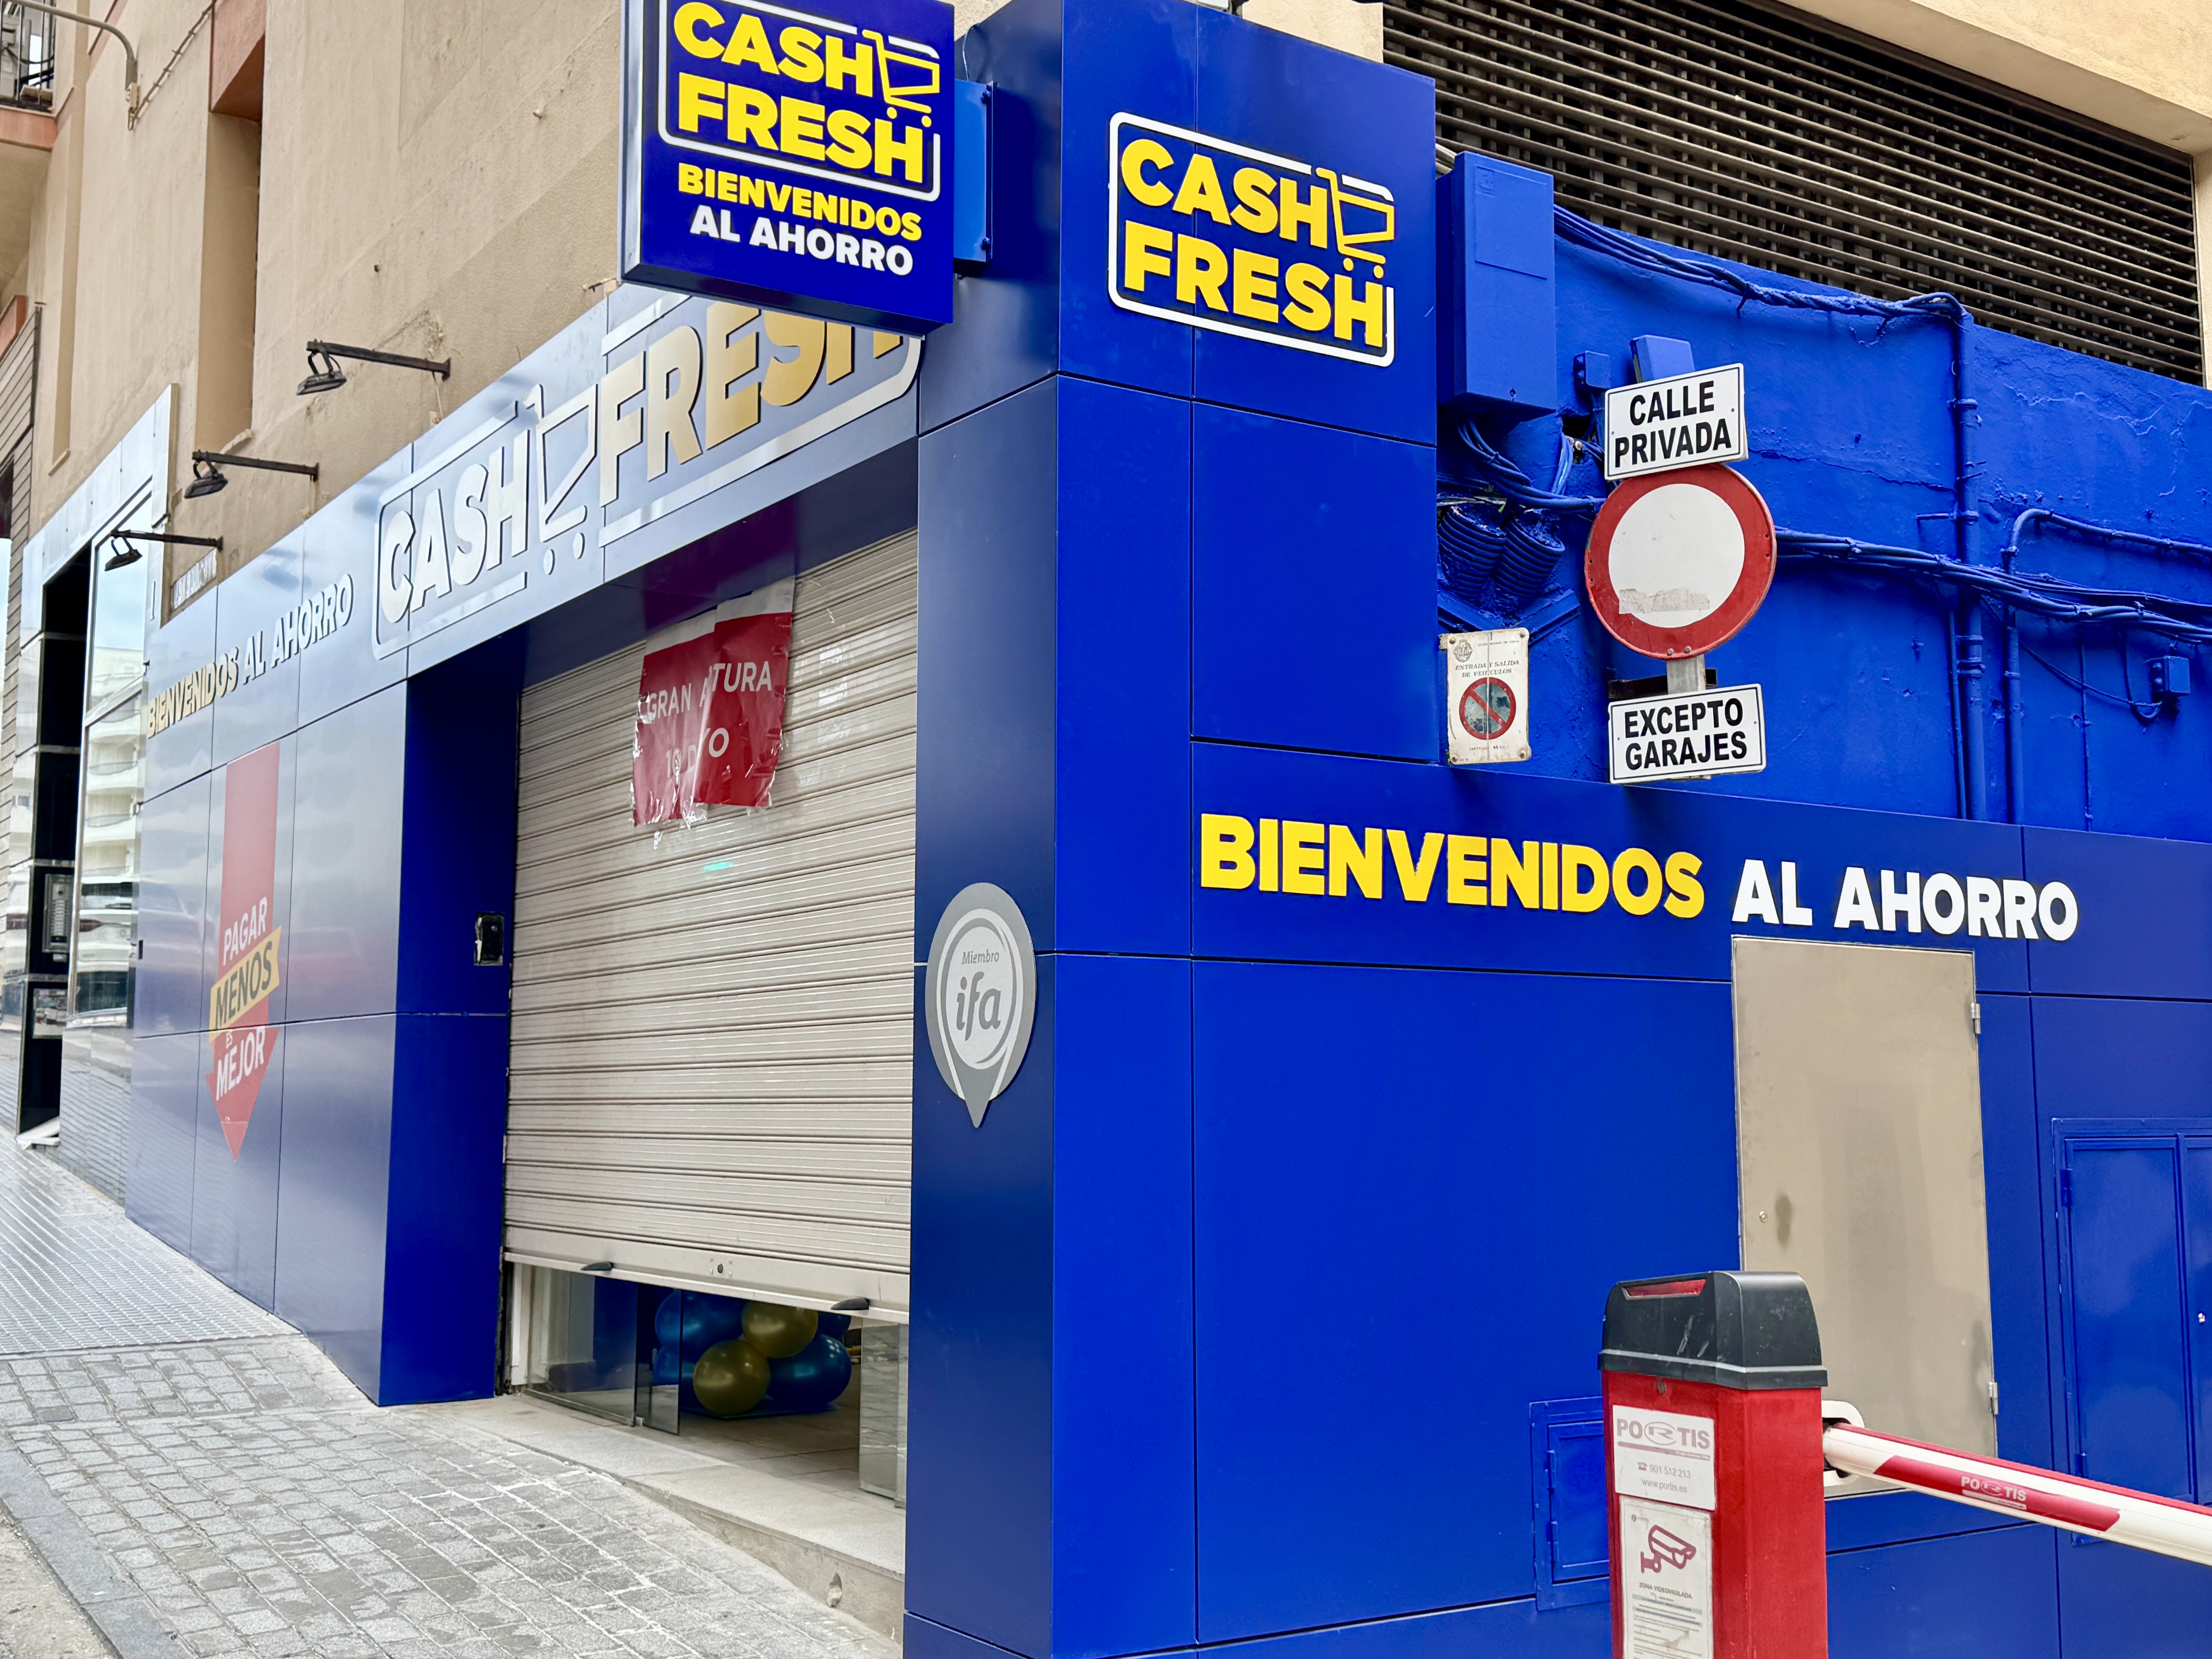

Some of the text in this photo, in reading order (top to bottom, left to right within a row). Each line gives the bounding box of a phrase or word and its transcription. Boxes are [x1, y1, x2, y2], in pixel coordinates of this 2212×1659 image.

[674, 2, 873, 97] CASH
[678, 72, 923, 183] FRESH
[678, 162, 922, 241] BIENVENIDOS
[1121, 138, 1328, 249] CASH
[690, 205, 913, 276] AL AHORRO
[1124, 220, 1382, 347] FRESH
[1630, 380, 1714, 426] CALLE
[381, 301, 903, 623] CASH FRES
[1615, 418, 1732, 468] PRIVADA
[148, 646, 239, 739] BIENVENIDOS
[242, 630, 266, 685] AL
[270, 573, 354, 669] AHORRO
[1455, 663, 1486, 671] ENTRADA
[647, 683, 692, 721] GRAN
[1625, 698, 1743, 738] EXCEPTO
[1626, 730, 1747, 770] GARAJES
[1200, 813, 2079, 943] BIENVENIDOS AL AHORRO
[223, 896, 268, 966] PAGAR
[961, 948, 1000, 965] Miembro
[215, 940, 273, 1030] MENOS
[956, 971, 1001, 1042] ifa
[216, 1025, 266, 1101] MEJOR
[1616, 1418, 1711, 1449] PORTIS
[1642, 1479, 1687, 1493] www.portis.es
[1650, 1464, 1691, 1479] 901 512 213
